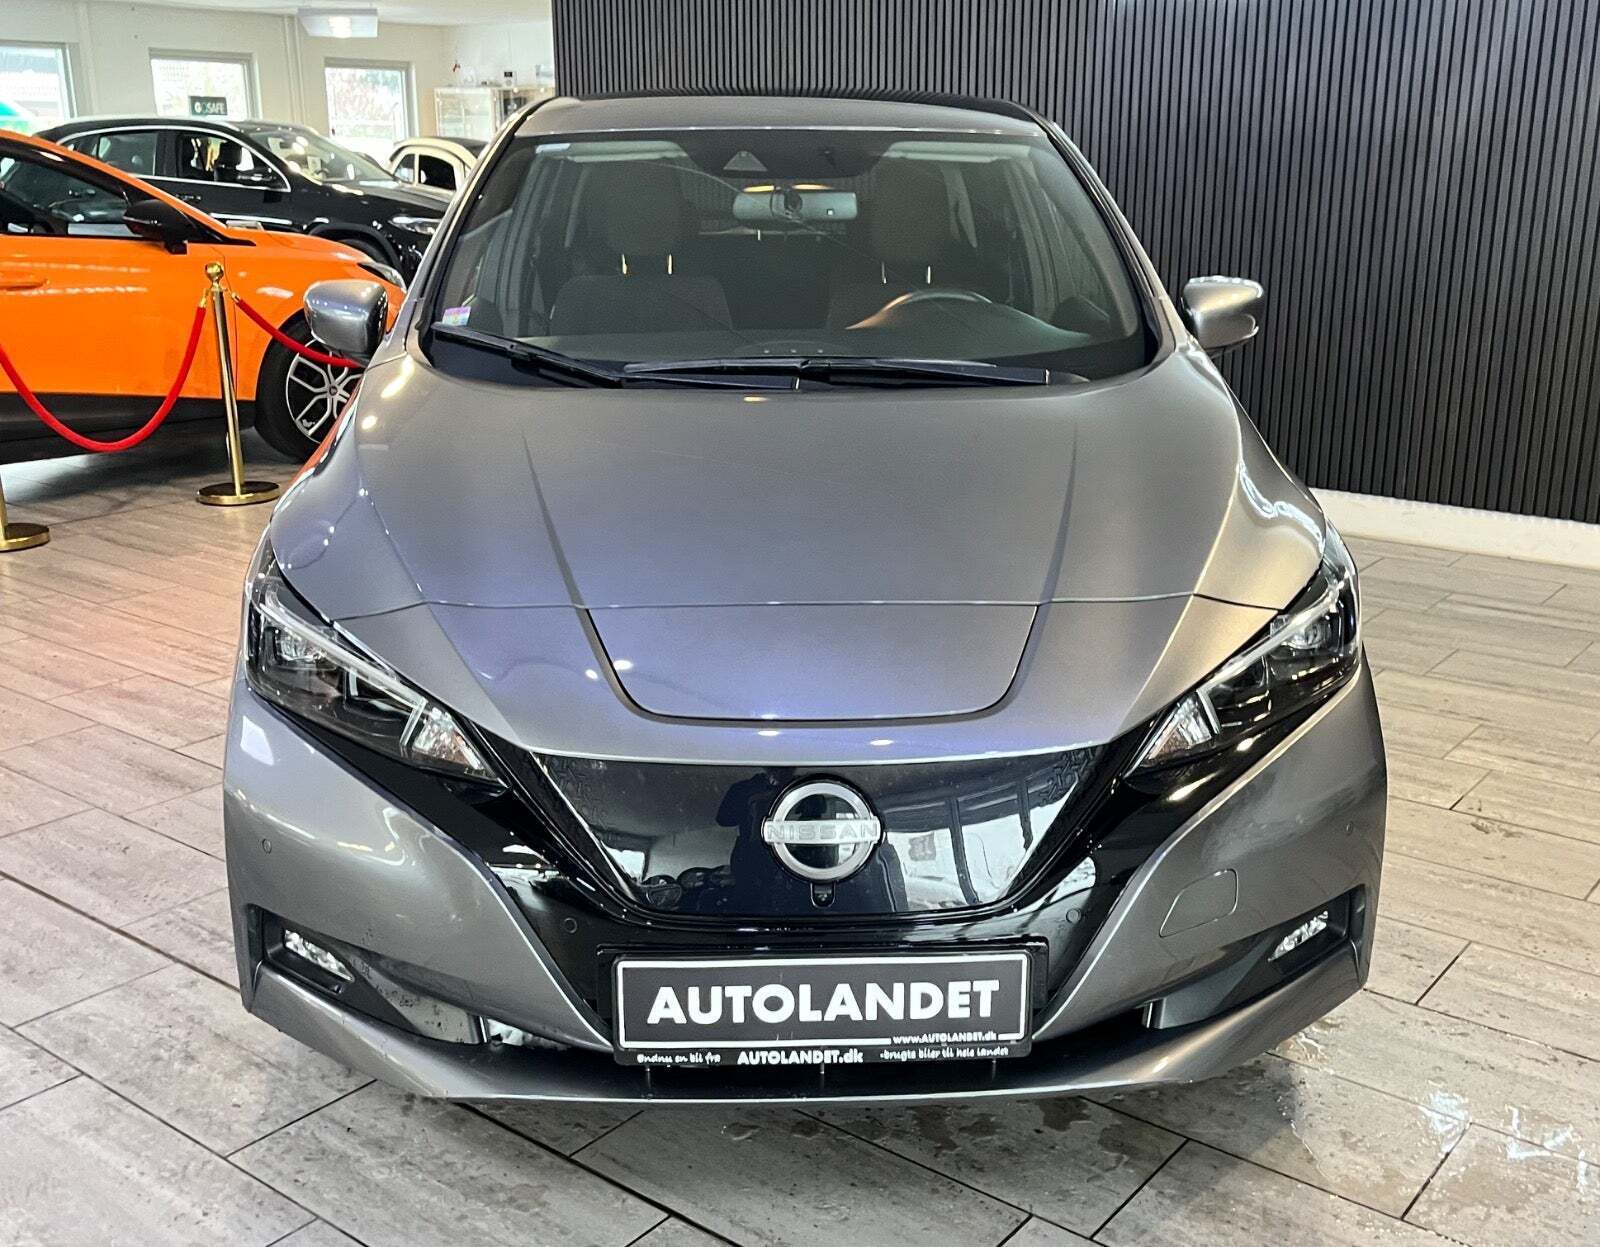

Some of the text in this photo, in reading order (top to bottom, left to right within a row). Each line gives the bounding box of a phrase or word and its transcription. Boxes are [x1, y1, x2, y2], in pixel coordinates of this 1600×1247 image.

[767, 823, 878, 841] NISSAN
[647, 979, 1000, 1025] AUTOLANDET
[892, 1030, 997, 1044] www.AUTOLANDET.dk
[737, 1049, 864, 1065] AUTOLANDET.dk
